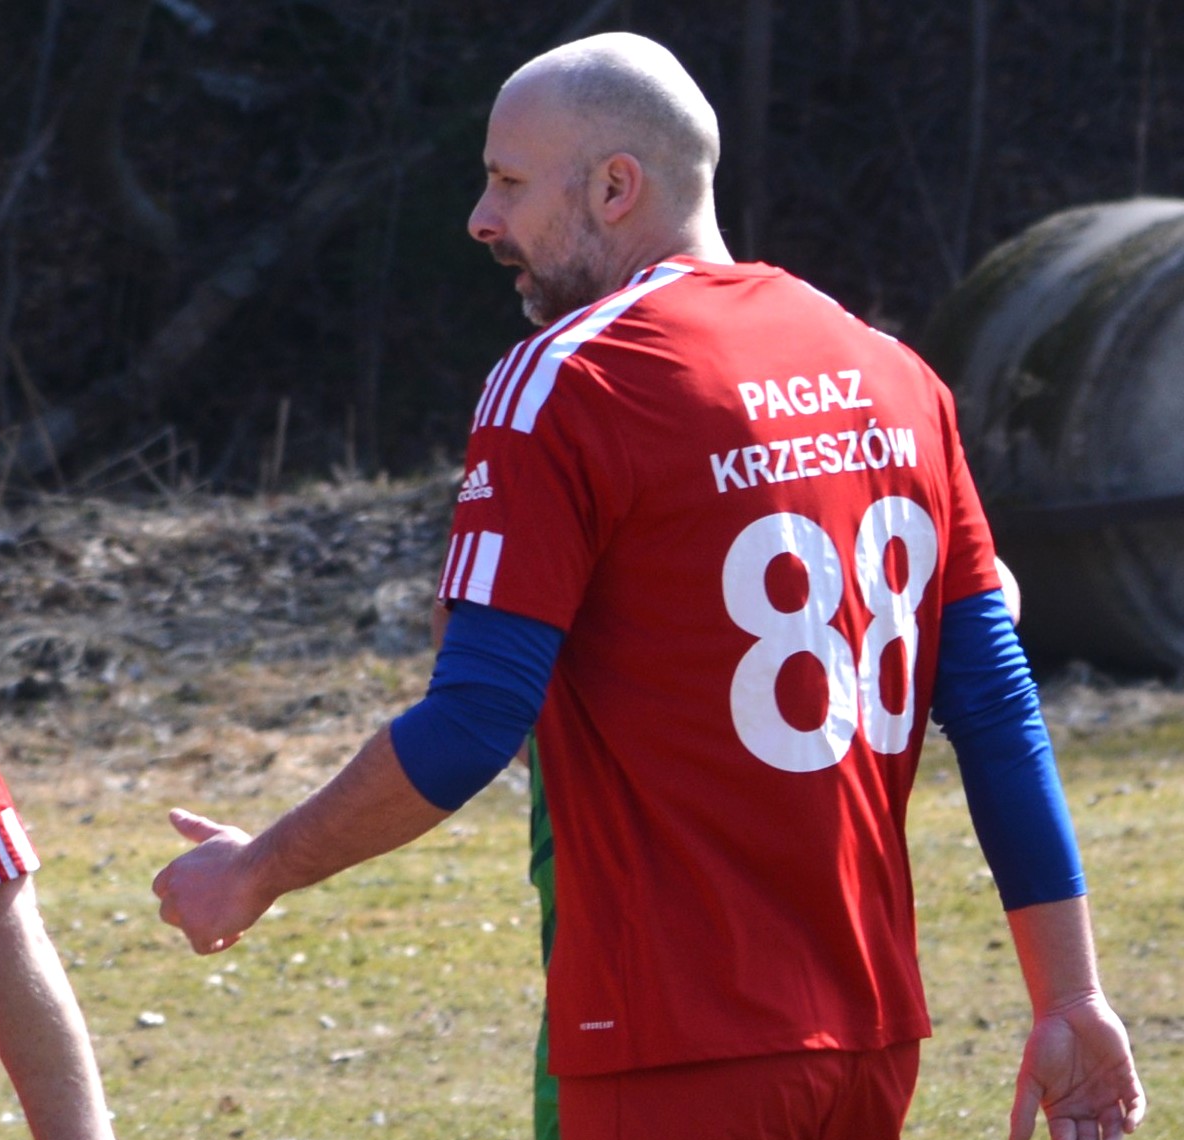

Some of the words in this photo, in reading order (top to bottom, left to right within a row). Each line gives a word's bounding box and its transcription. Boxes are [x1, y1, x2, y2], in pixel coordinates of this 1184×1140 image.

[738, 369, 872, 421] PAGAZ
[710, 419, 917, 493] KRZESZÓW
[722, 496, 938, 773] 88
